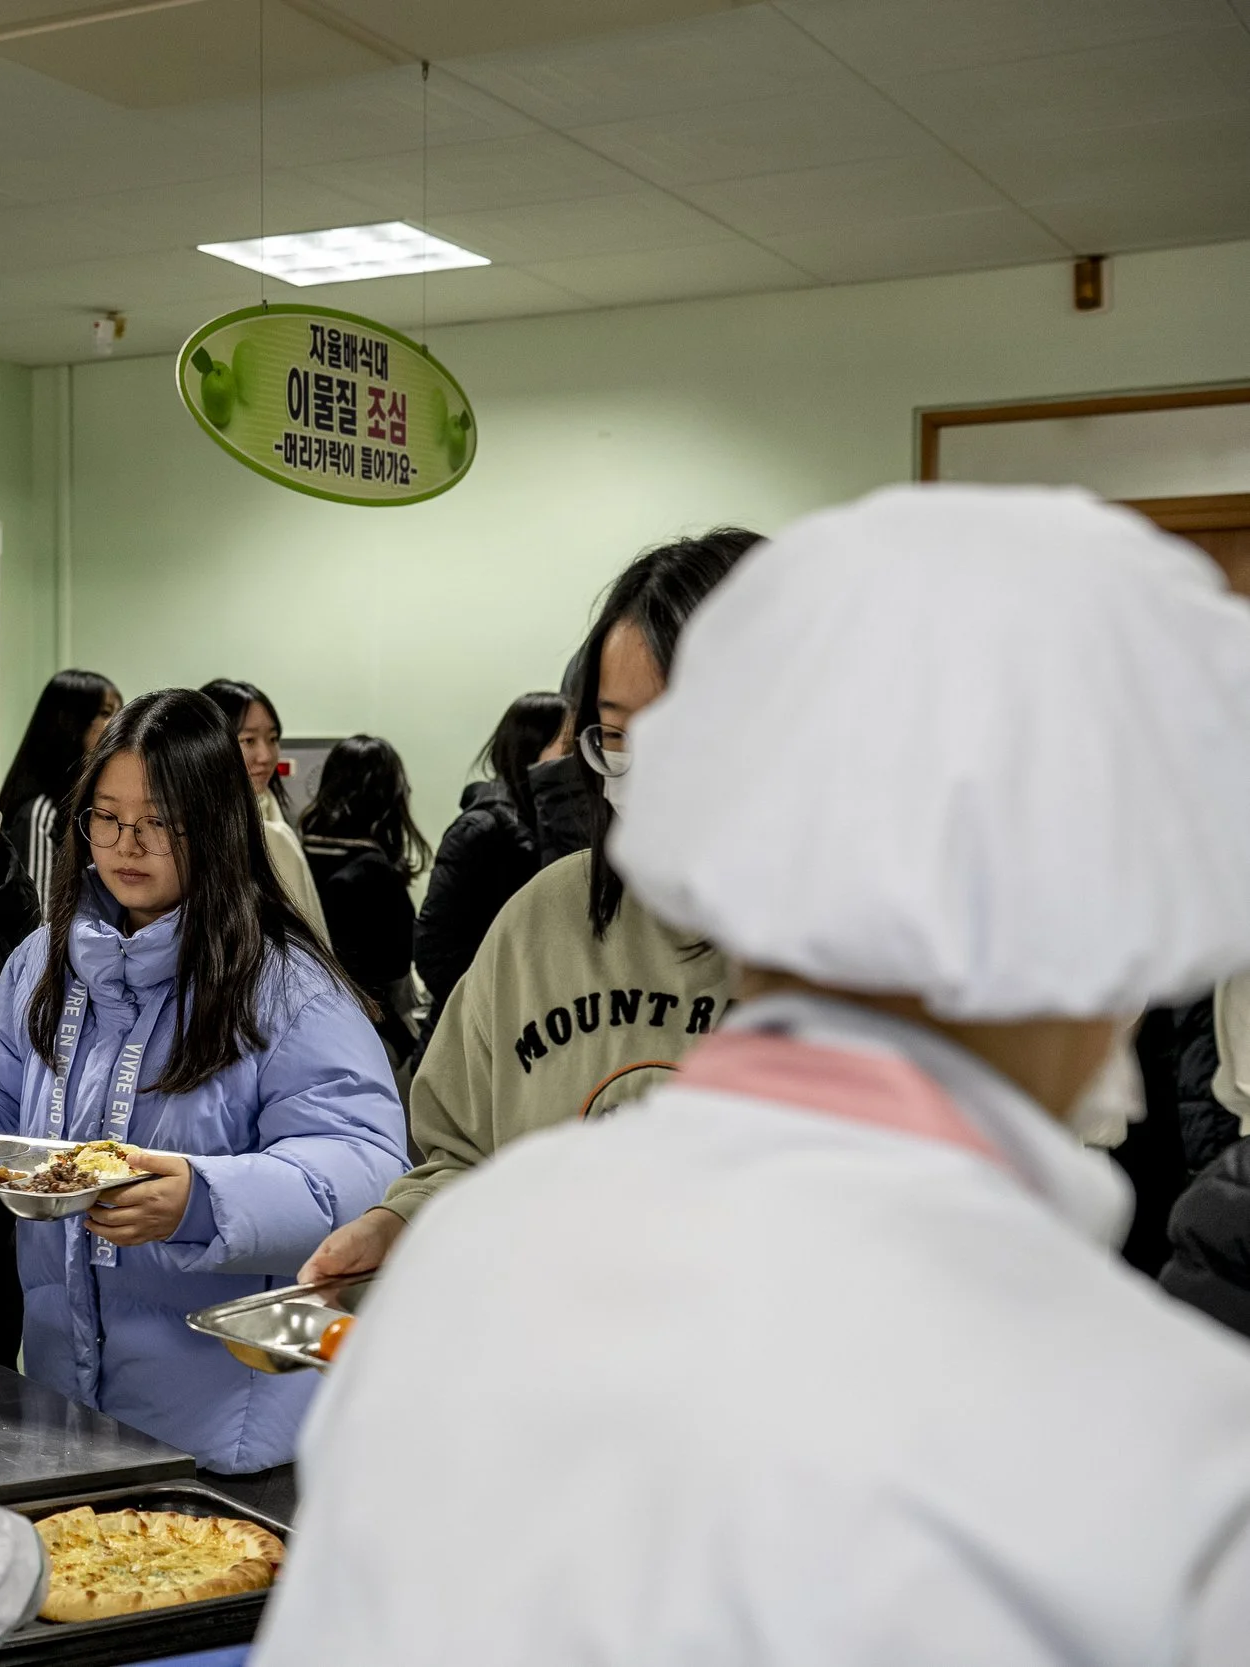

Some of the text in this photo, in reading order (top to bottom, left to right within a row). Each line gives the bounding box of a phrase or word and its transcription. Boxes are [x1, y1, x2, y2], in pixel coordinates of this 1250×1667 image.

[309, 324, 388, 381] 자율배식대
[287, 367, 406, 446] 이물질 조심
[60, 1023, 77, 1047] EN
[515, 988, 679, 1074] MOUNT
[50, 1053, 70, 1124] ACCORD
[115, 1043, 144, 1094] VIVRE
[110, 1100, 129, 1125] EN
